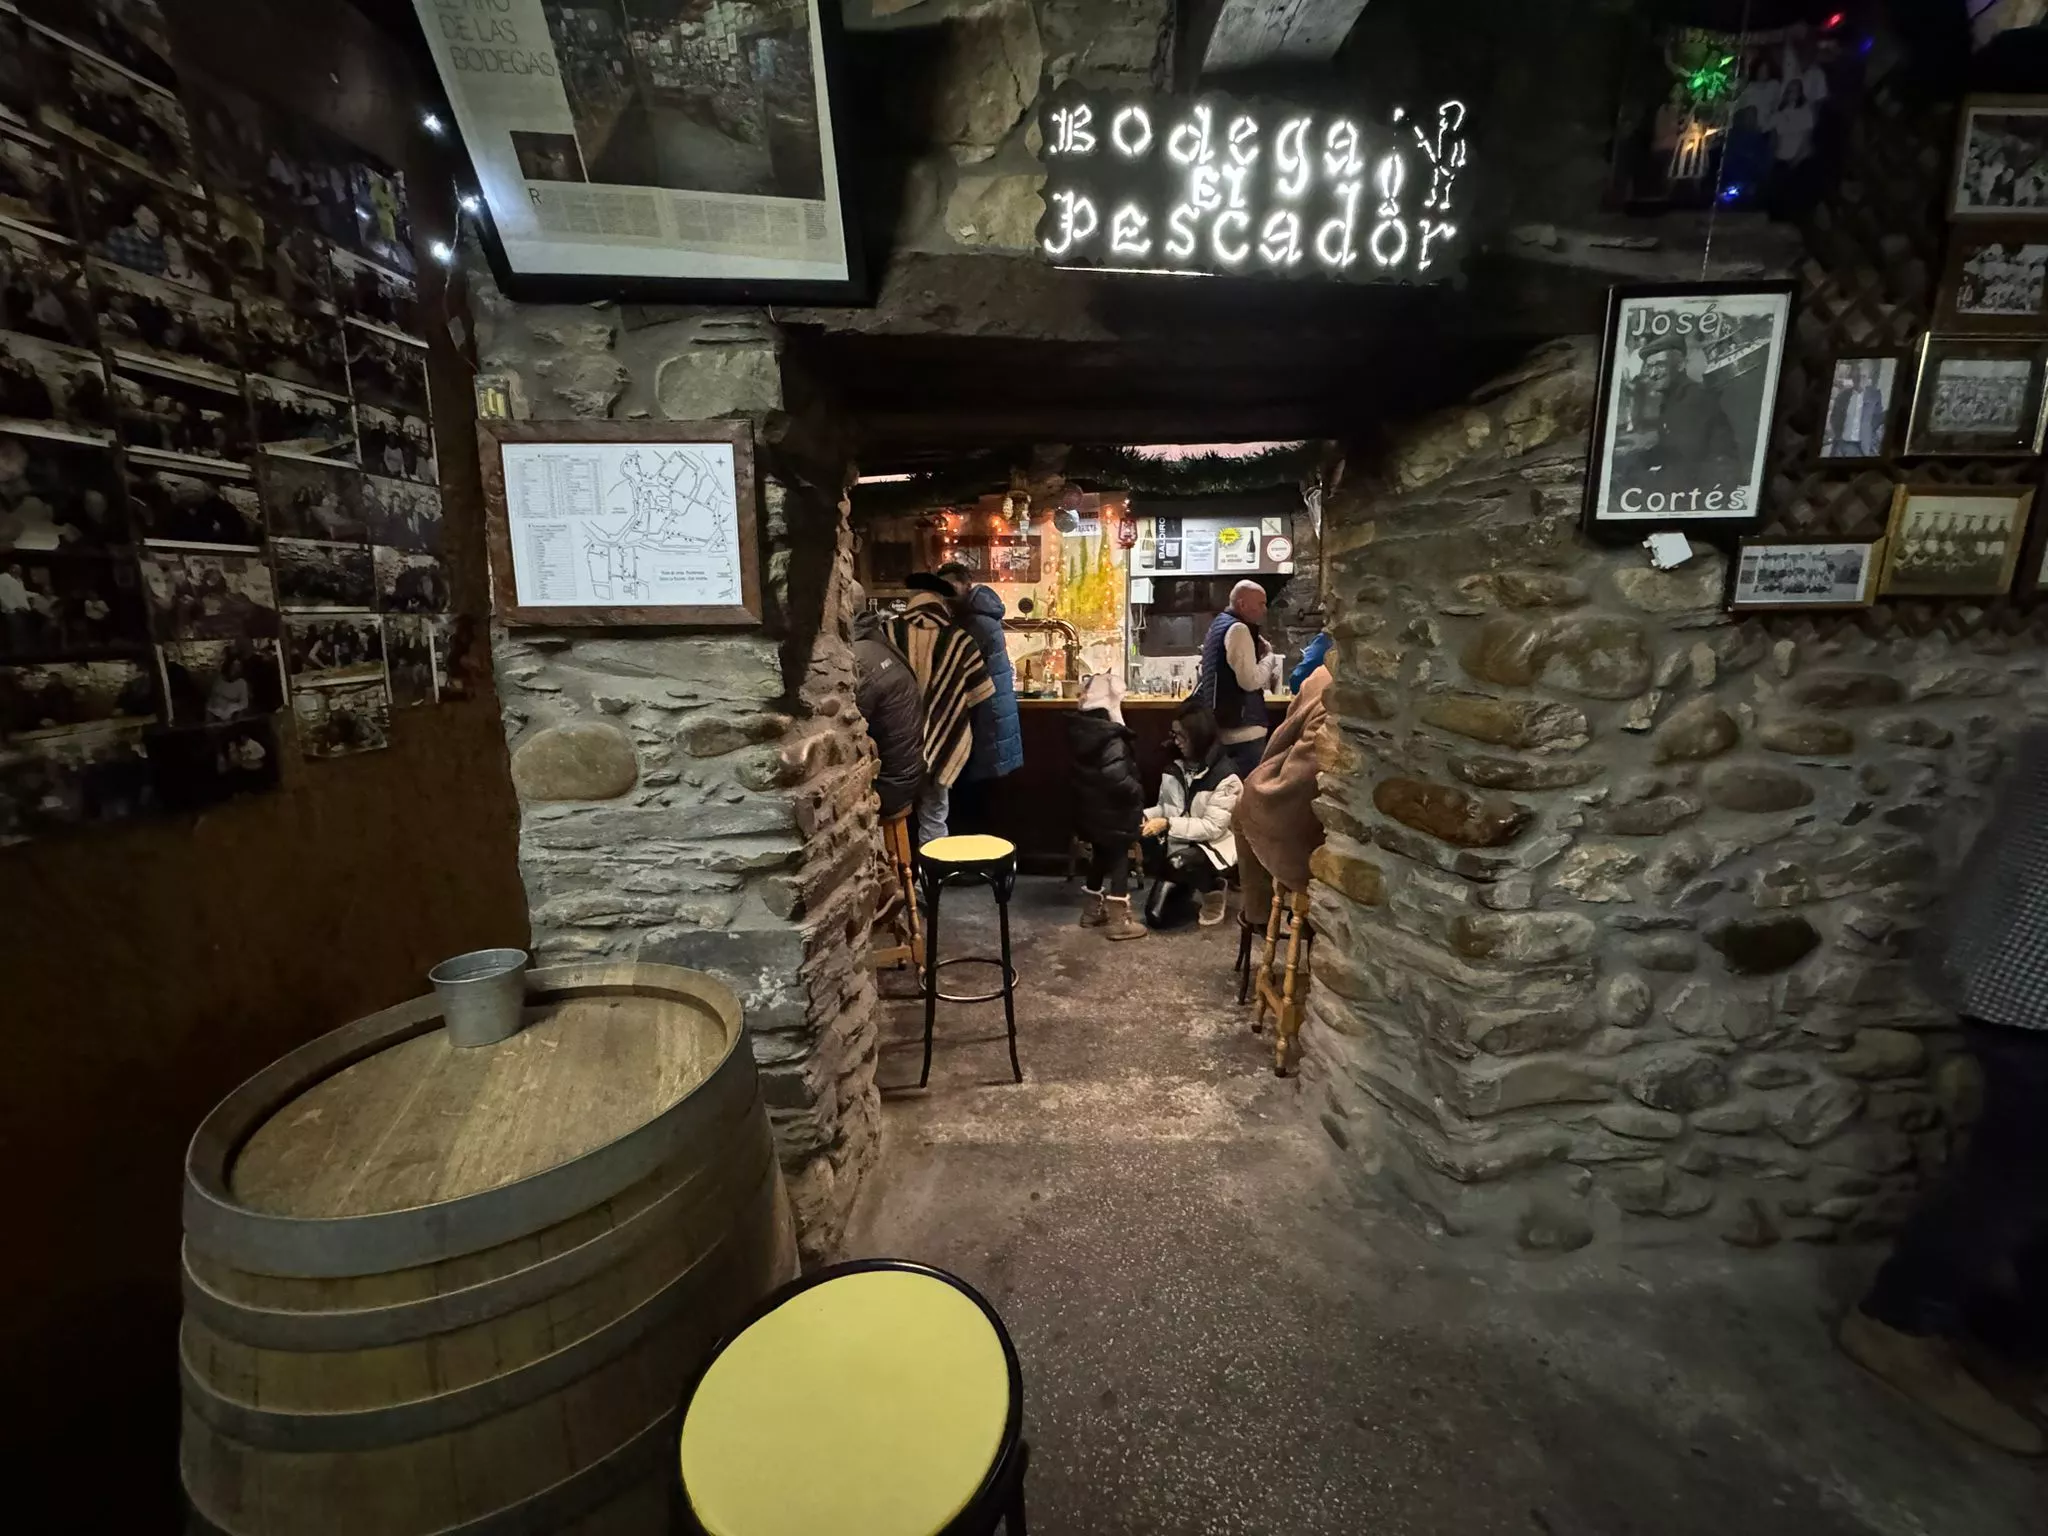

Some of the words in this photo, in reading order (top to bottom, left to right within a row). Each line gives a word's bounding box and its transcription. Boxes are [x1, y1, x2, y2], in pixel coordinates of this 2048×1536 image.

[438, 14, 474, 41] DE
[474, 18, 518, 44] LAS
[450, 46, 555, 77] BODEGAS
[528, 188, 543, 206] R
[1631, 303, 1721, 336] José
[1620, 484, 1748, 512] Cortés
